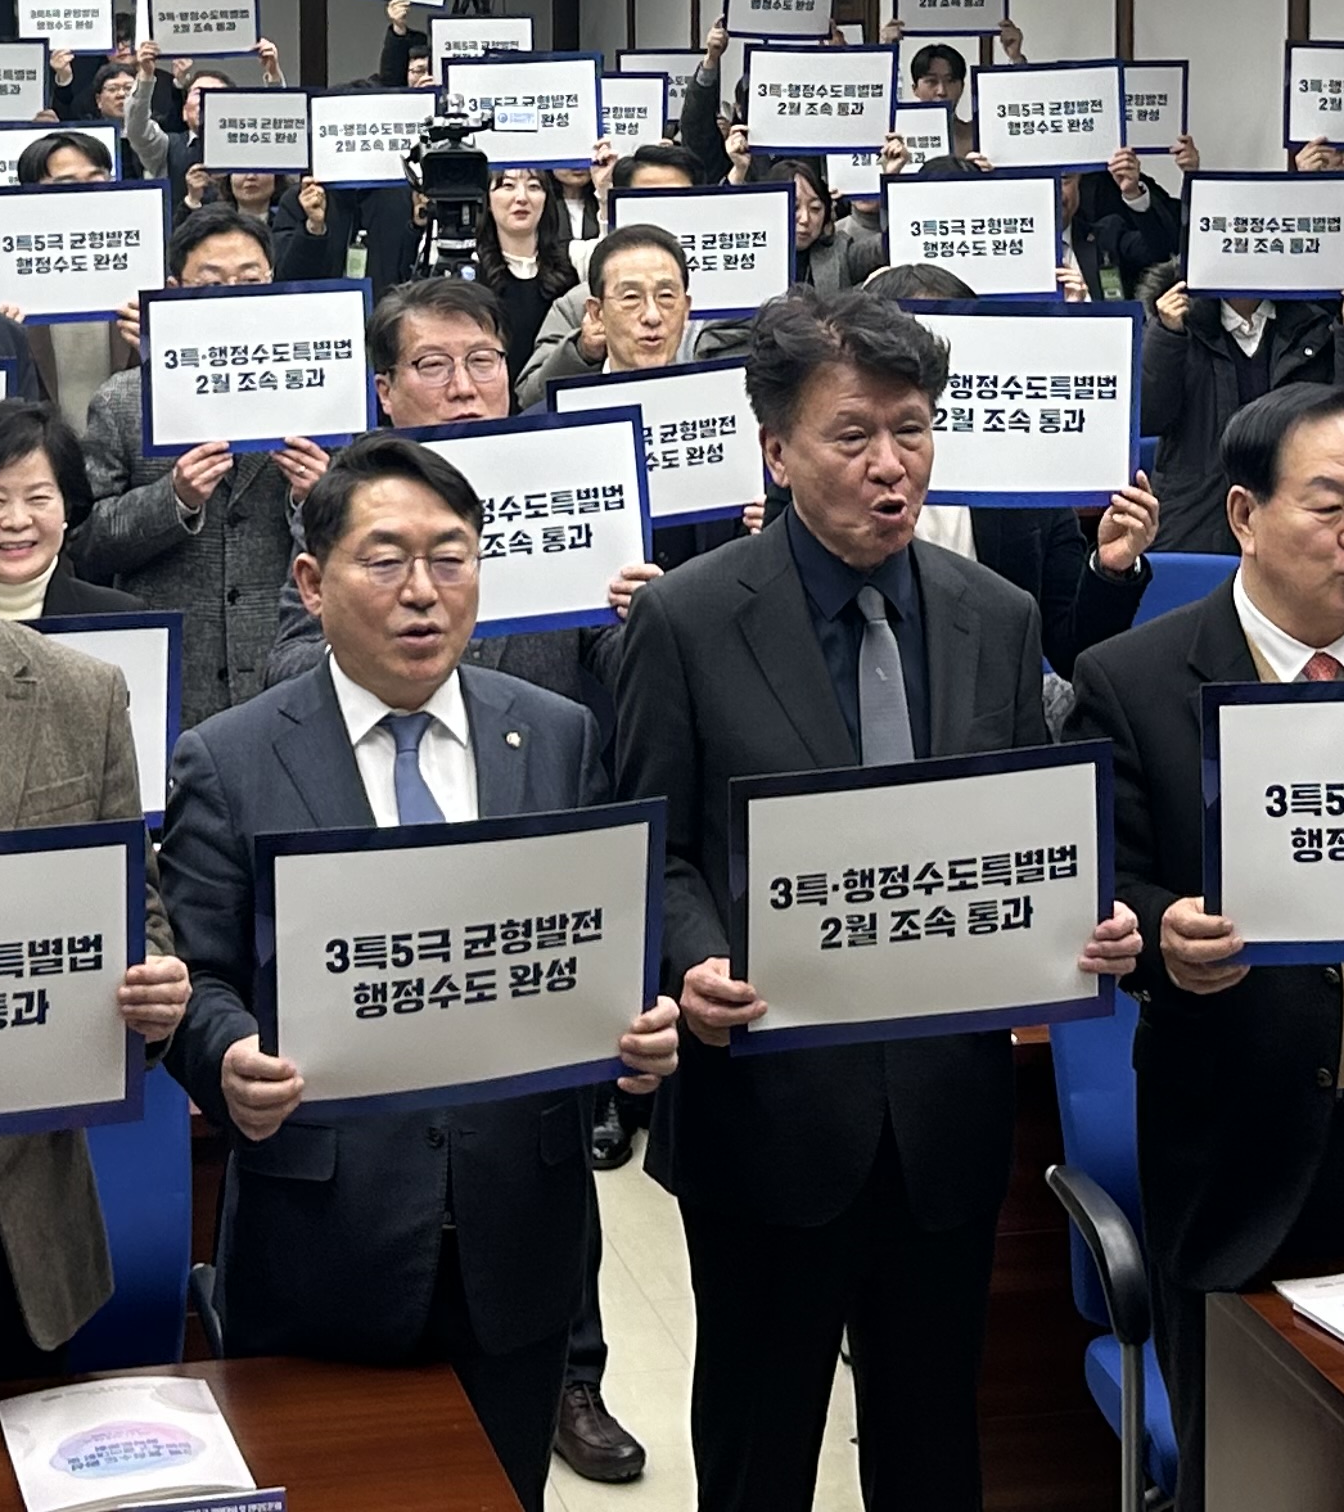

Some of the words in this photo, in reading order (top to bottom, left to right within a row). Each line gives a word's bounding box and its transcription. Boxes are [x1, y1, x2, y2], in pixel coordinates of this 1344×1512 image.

[778, 102, 801, 115] 2월
[806, 103, 832, 116] 조속
[838, 102, 864, 116] 통과
[997, 103, 1045, 118] 3특5극
[1049, 99, 1103, 115] 균형발전
[1319, 98, 1342, 111] 2월
[541, 113, 569, 127] 완성
[1137, 109, 1159, 121] 완성
[615, 123, 638, 135] 완성
[1008, 120, 1063, 135] 행정수도
[1068, 118, 1094, 132] 완성
[336, 140, 355, 152] 2월
[360, 139, 384, 151] 조속
[911, 220, 965, 236] 3특5극
[971, 217, 1034, 235] 균형발전
[3, 234, 63, 252] 3특5극
[70, 230, 140, 249] 균형발전
[702, 231, 766, 250] 균형발전
[923, 241, 987, 258] 행정수도
[992, 239, 1023, 255] 완성
[1222, 238, 1248, 253] 2월
[1254, 238, 1284, 253] 조속
[1290, 238, 1320, 254] 통과
[16, 256, 87, 275] 행정수도
[94, 253, 127, 270] 완성
[724, 253, 754, 270] 완성
[164, 339, 352, 369] 3특·행정수도특별법
[196, 373, 230, 394] 2월
[238, 371, 277, 392] 조속
[286, 368, 325, 389] 통과
[660, 415, 736, 443] 균형발전
[933, 407, 973, 434] 2월
[983, 409, 1030, 433] 조속
[1040, 409, 1085, 433] 통과
[686, 443, 723, 466] 완성
[479, 531, 532, 562] 조속
[542, 523, 592, 553] 통과
[770, 845, 1077, 910] 3특·행정수도특별법
[821, 913, 877, 950] 2월
[889, 906, 956, 942] 조속
[968, 895, 1033, 935] 통과
[326, 929, 451, 973] 3특5극
[464, 908, 602, 960] 균형발전
[354, 969, 497, 1019] 행정수도
[509, 957, 576, 998] 완성
